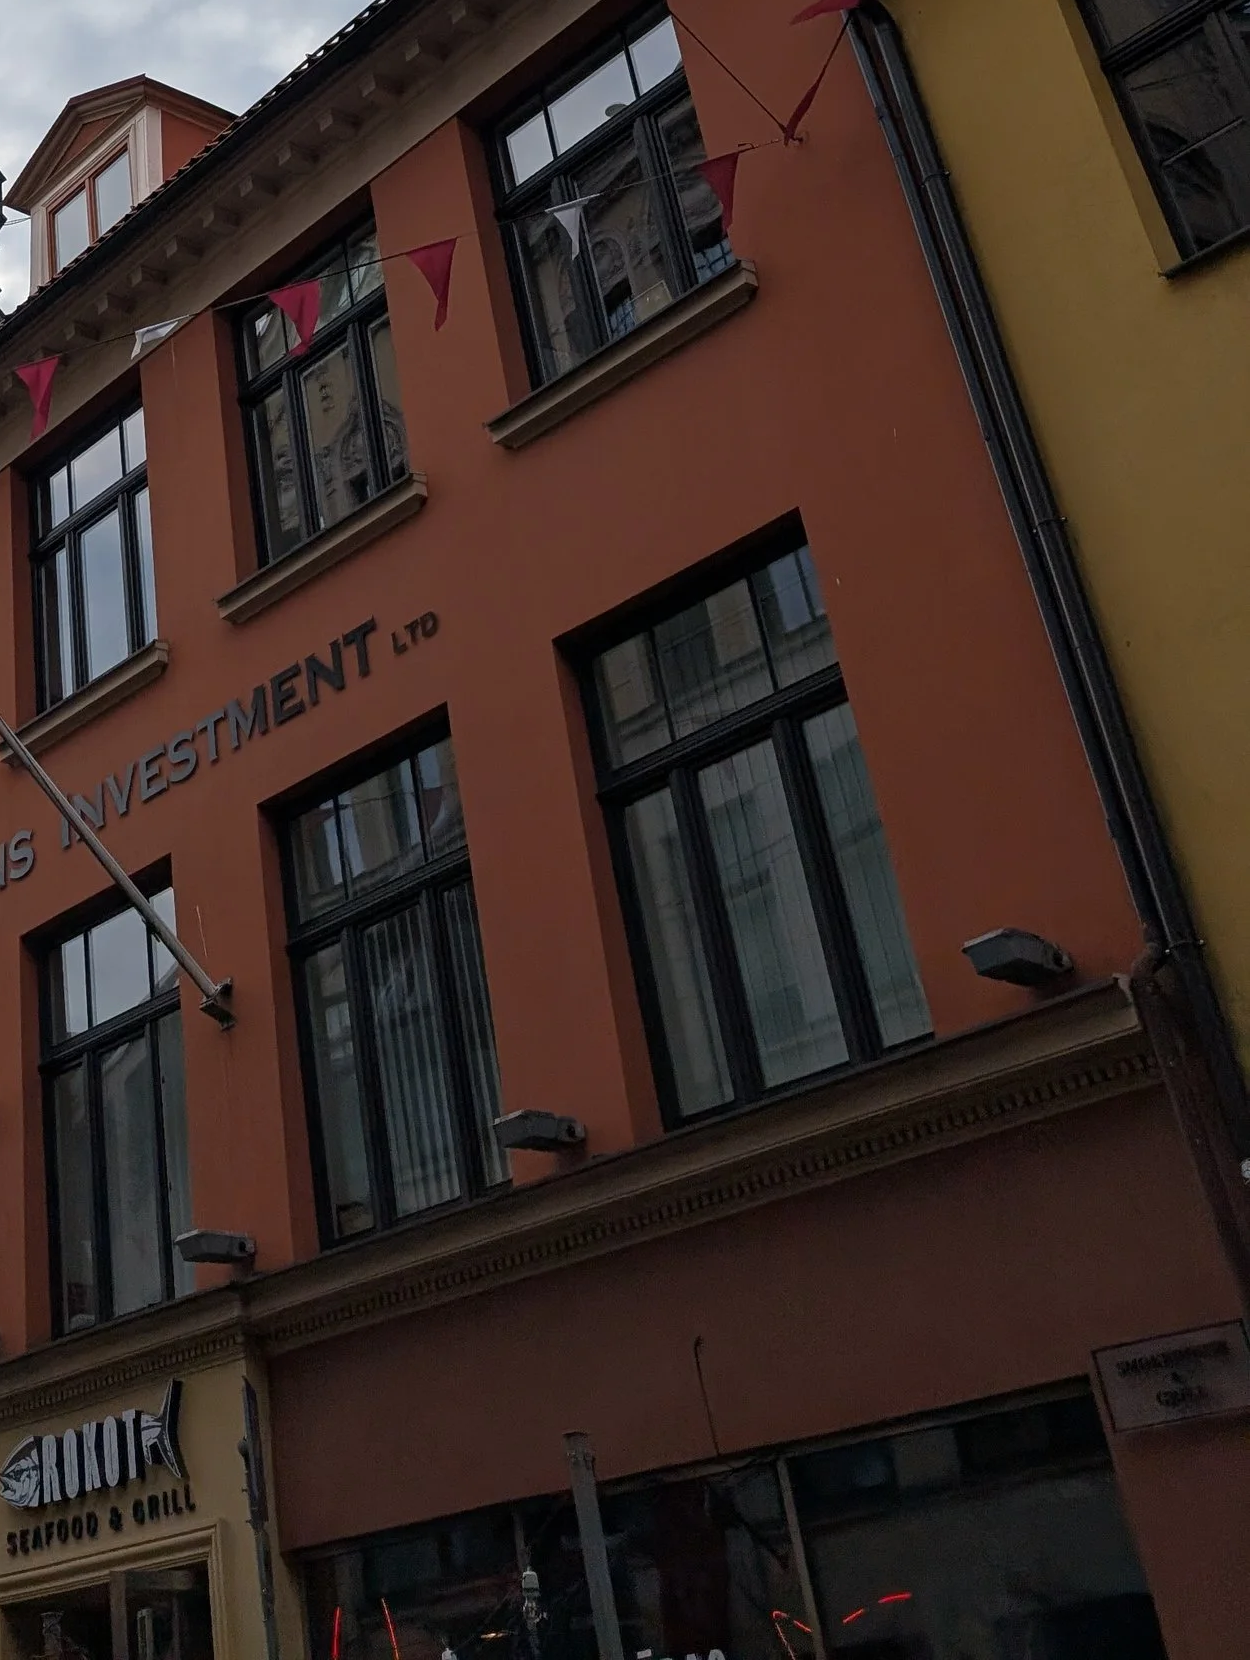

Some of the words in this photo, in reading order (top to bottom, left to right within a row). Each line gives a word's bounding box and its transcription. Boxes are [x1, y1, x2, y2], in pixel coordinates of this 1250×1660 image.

[61, 614, 379, 851] INVESTMENT
[391, 610, 440, 656] LTD
[6, 1511, 99, 1558] SEAFOOD
[109, 1506, 124, 1532] &
[132, 1484, 196, 1525] GRILL
